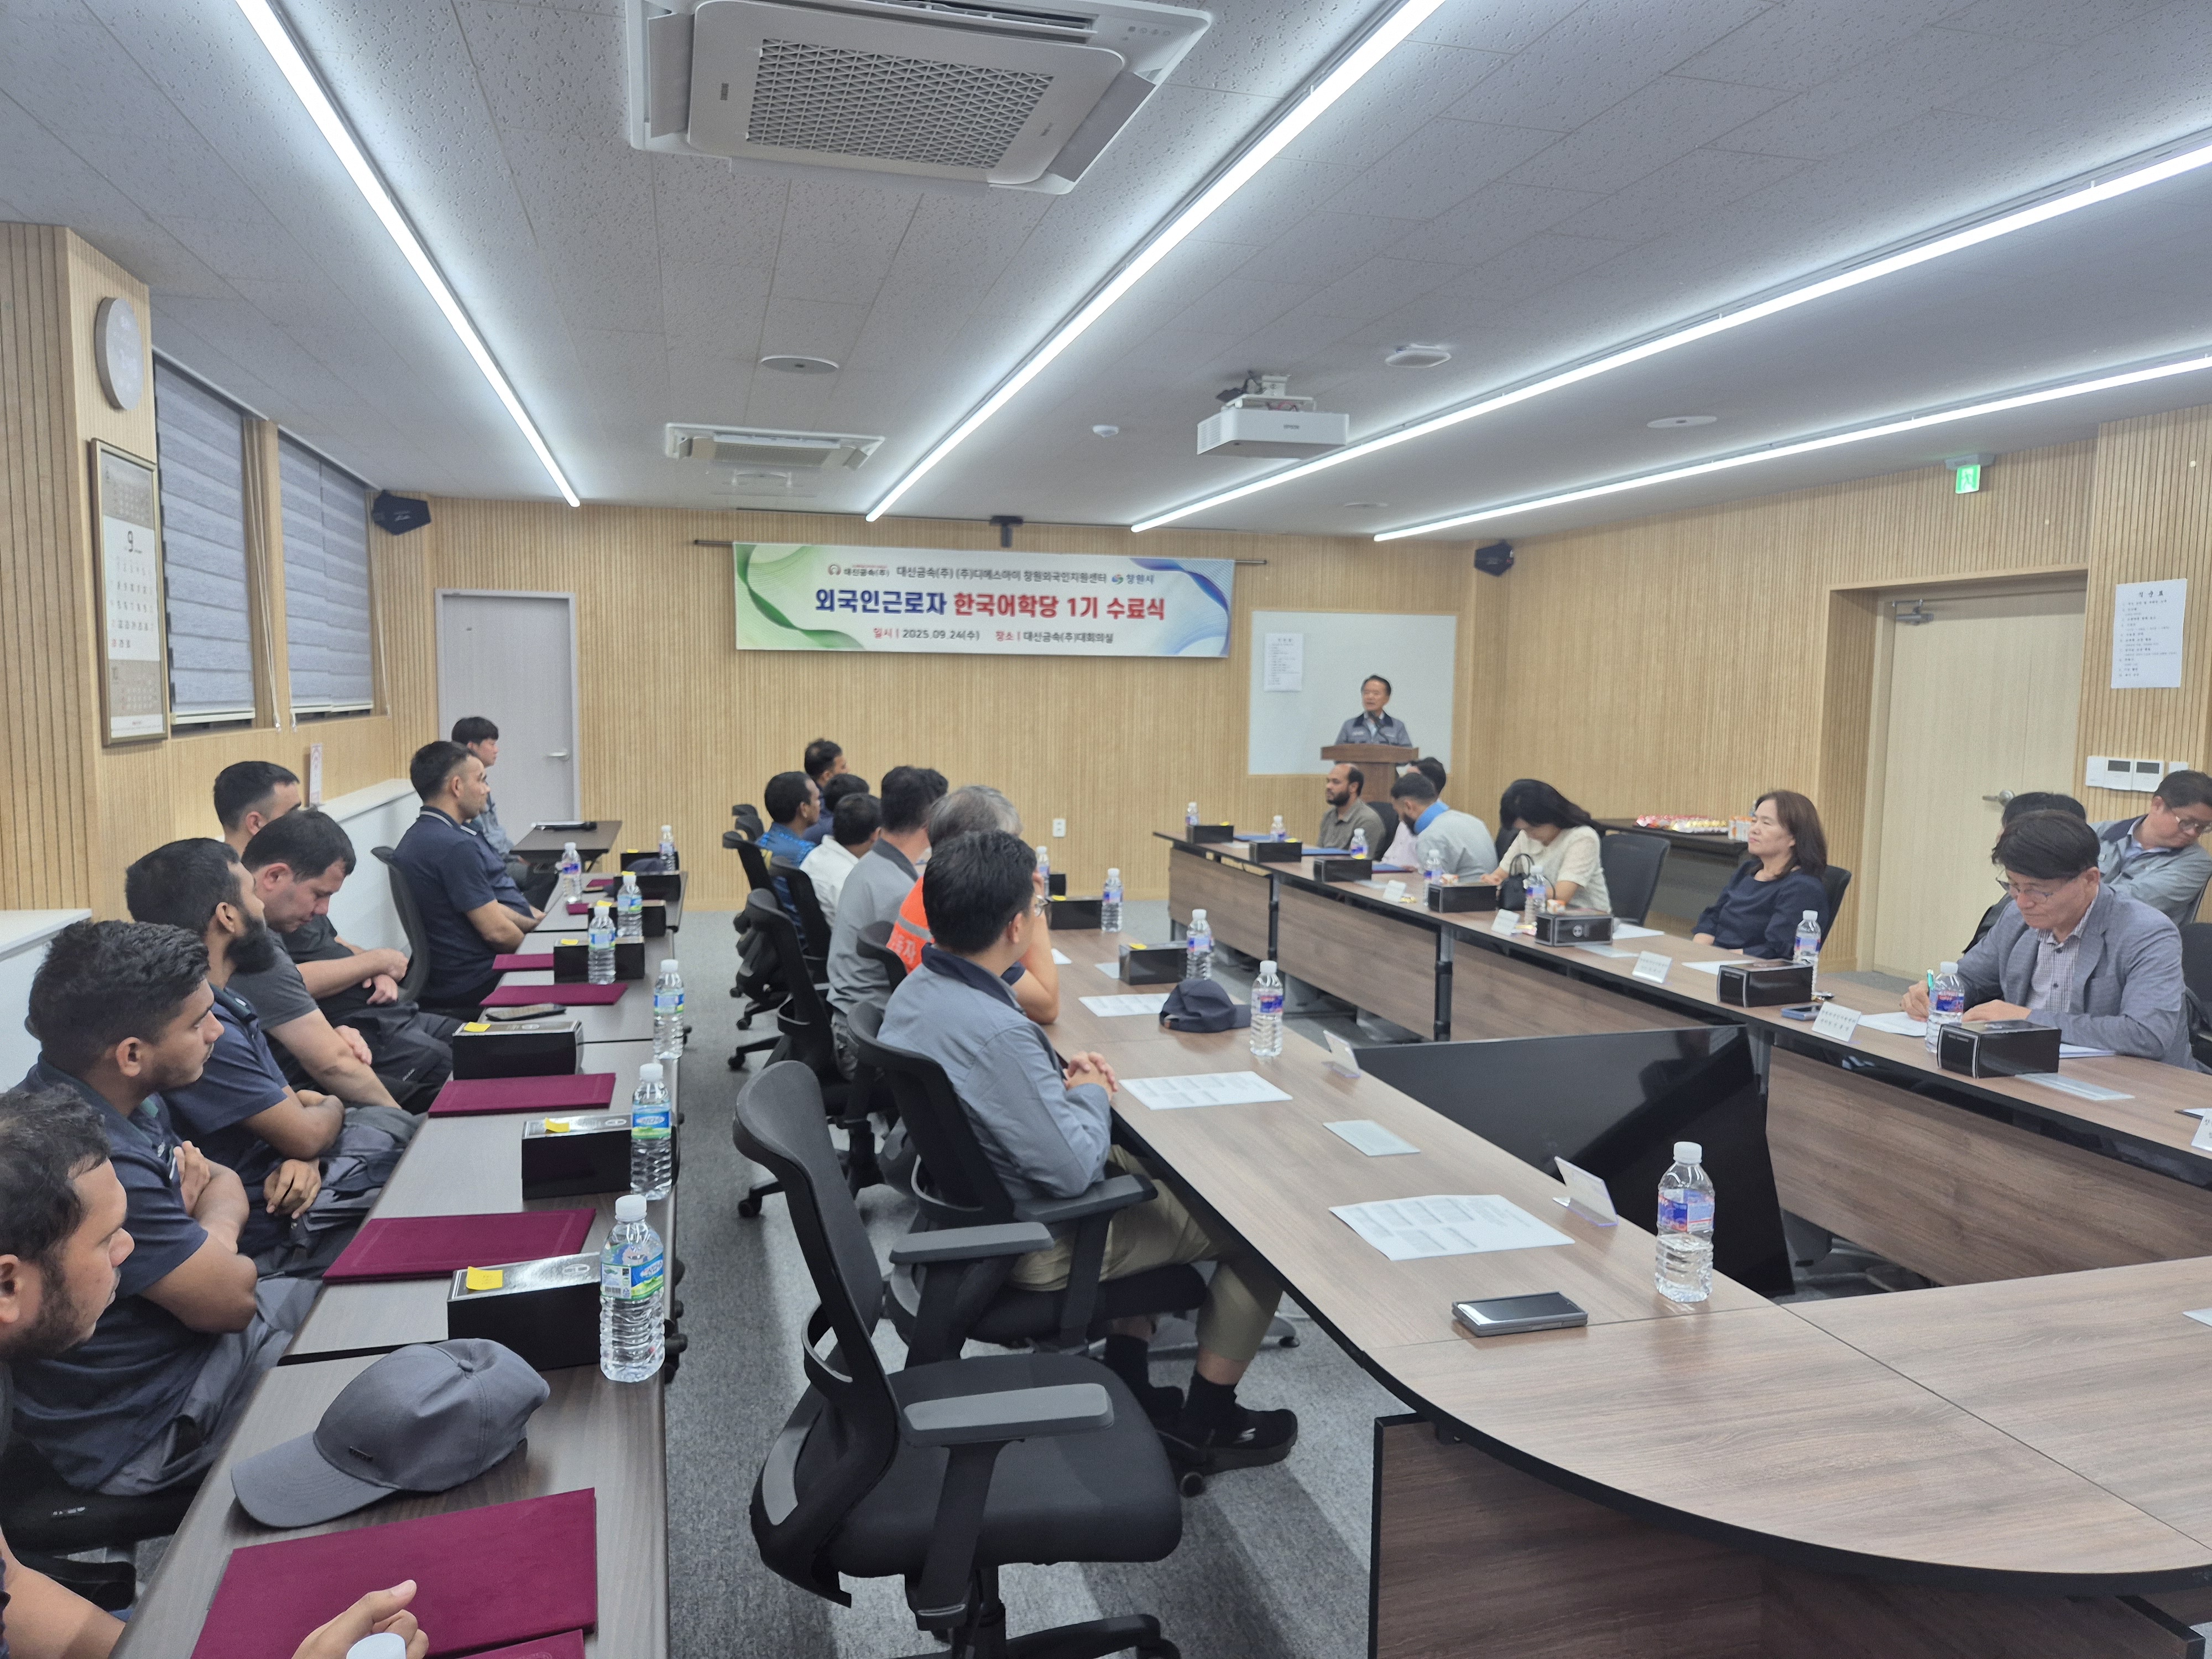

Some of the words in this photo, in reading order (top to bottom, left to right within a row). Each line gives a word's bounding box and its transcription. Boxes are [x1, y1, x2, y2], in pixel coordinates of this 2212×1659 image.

[896, 566, 953, 579] 대신금속(주)
[1024, 570, 1107, 584] 창원외국인지원센터
[1126, 573, 1155, 585] 창원시
[815, 588, 947, 615] 외국인근로자
[953, 592, 1060, 618] 한국어학당
[1067, 596, 1098, 619] 1기
[1107, 597, 1165, 620] 수료식
[874, 628, 893, 639] 일시
[902, 629, 980, 641] 2025.09.24(수)
[995, 630, 1014, 641] 장소
